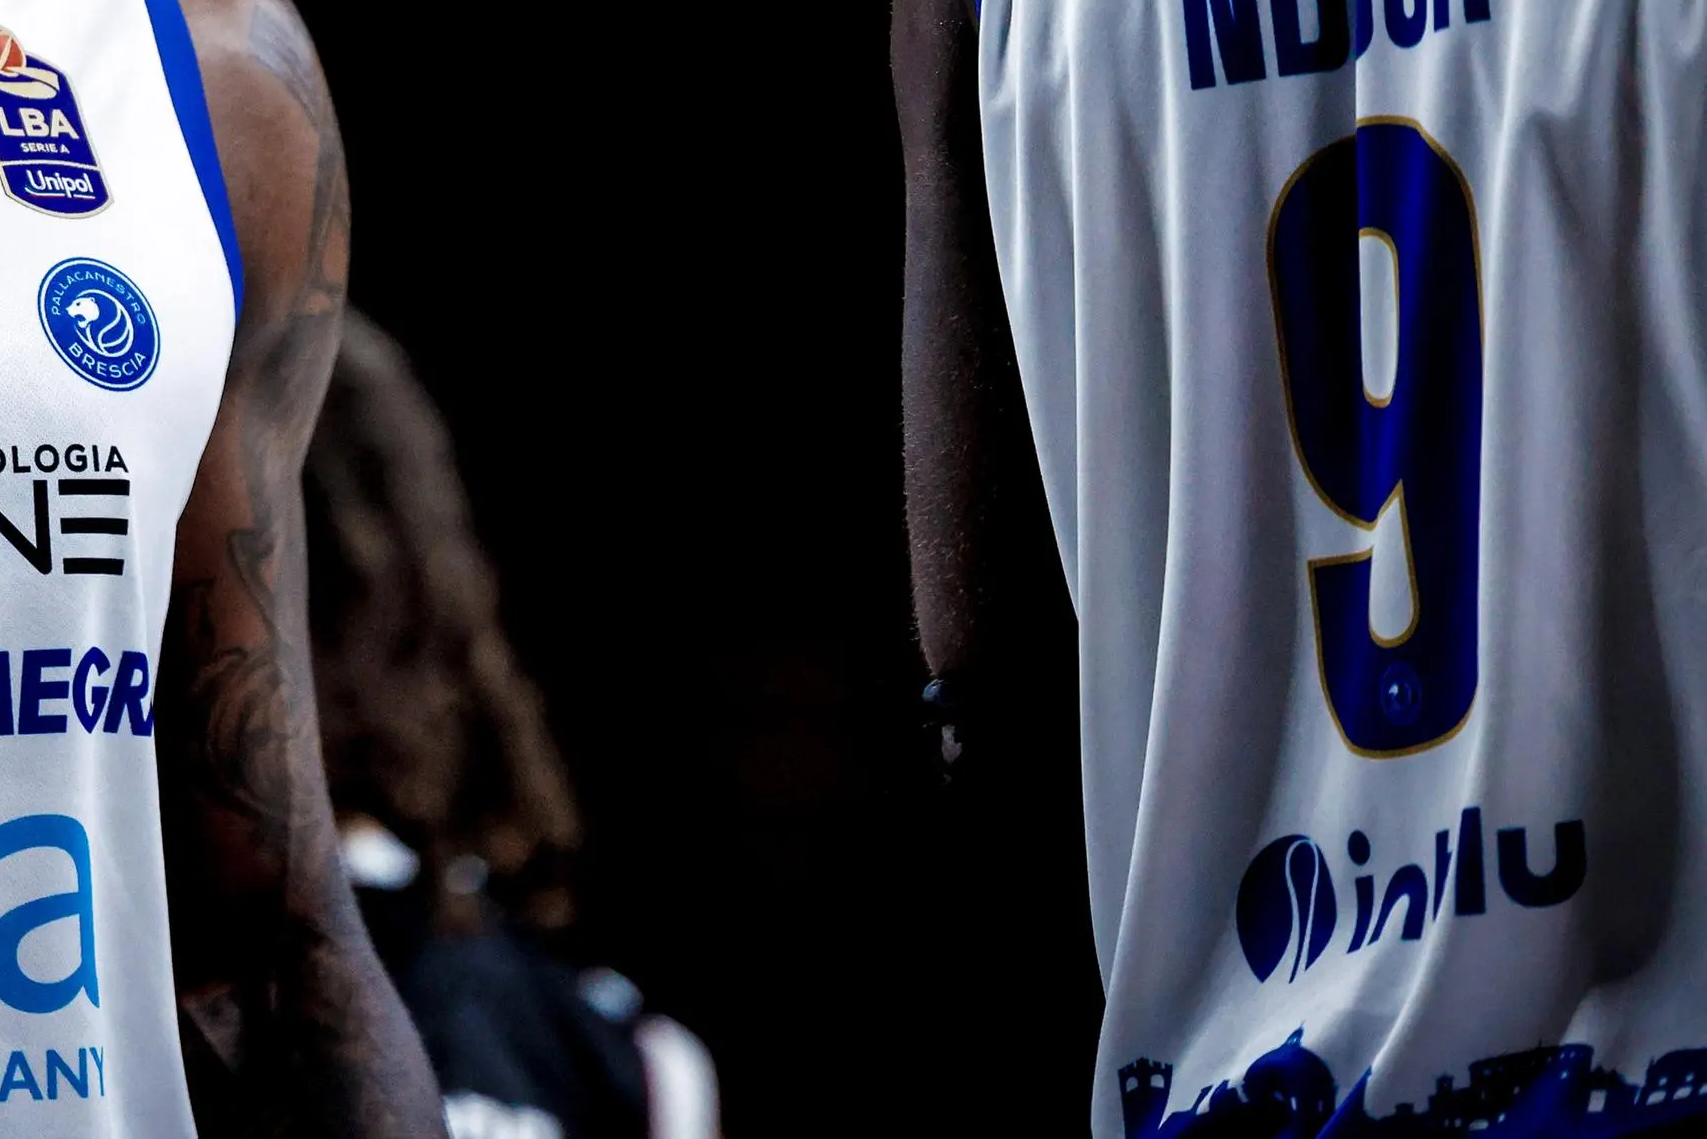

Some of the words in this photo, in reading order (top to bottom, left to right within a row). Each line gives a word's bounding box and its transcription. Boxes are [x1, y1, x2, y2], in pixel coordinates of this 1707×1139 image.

[20, 142, 59, 154] SERIE
[60, 143, 71, 155] A
[26, 169, 94, 199] Unipol
[51, 270, 146, 324] PALLACANESTRO
[68, 342, 147, 379] BRESCIA
[1266, 114, 1486, 760] 9
